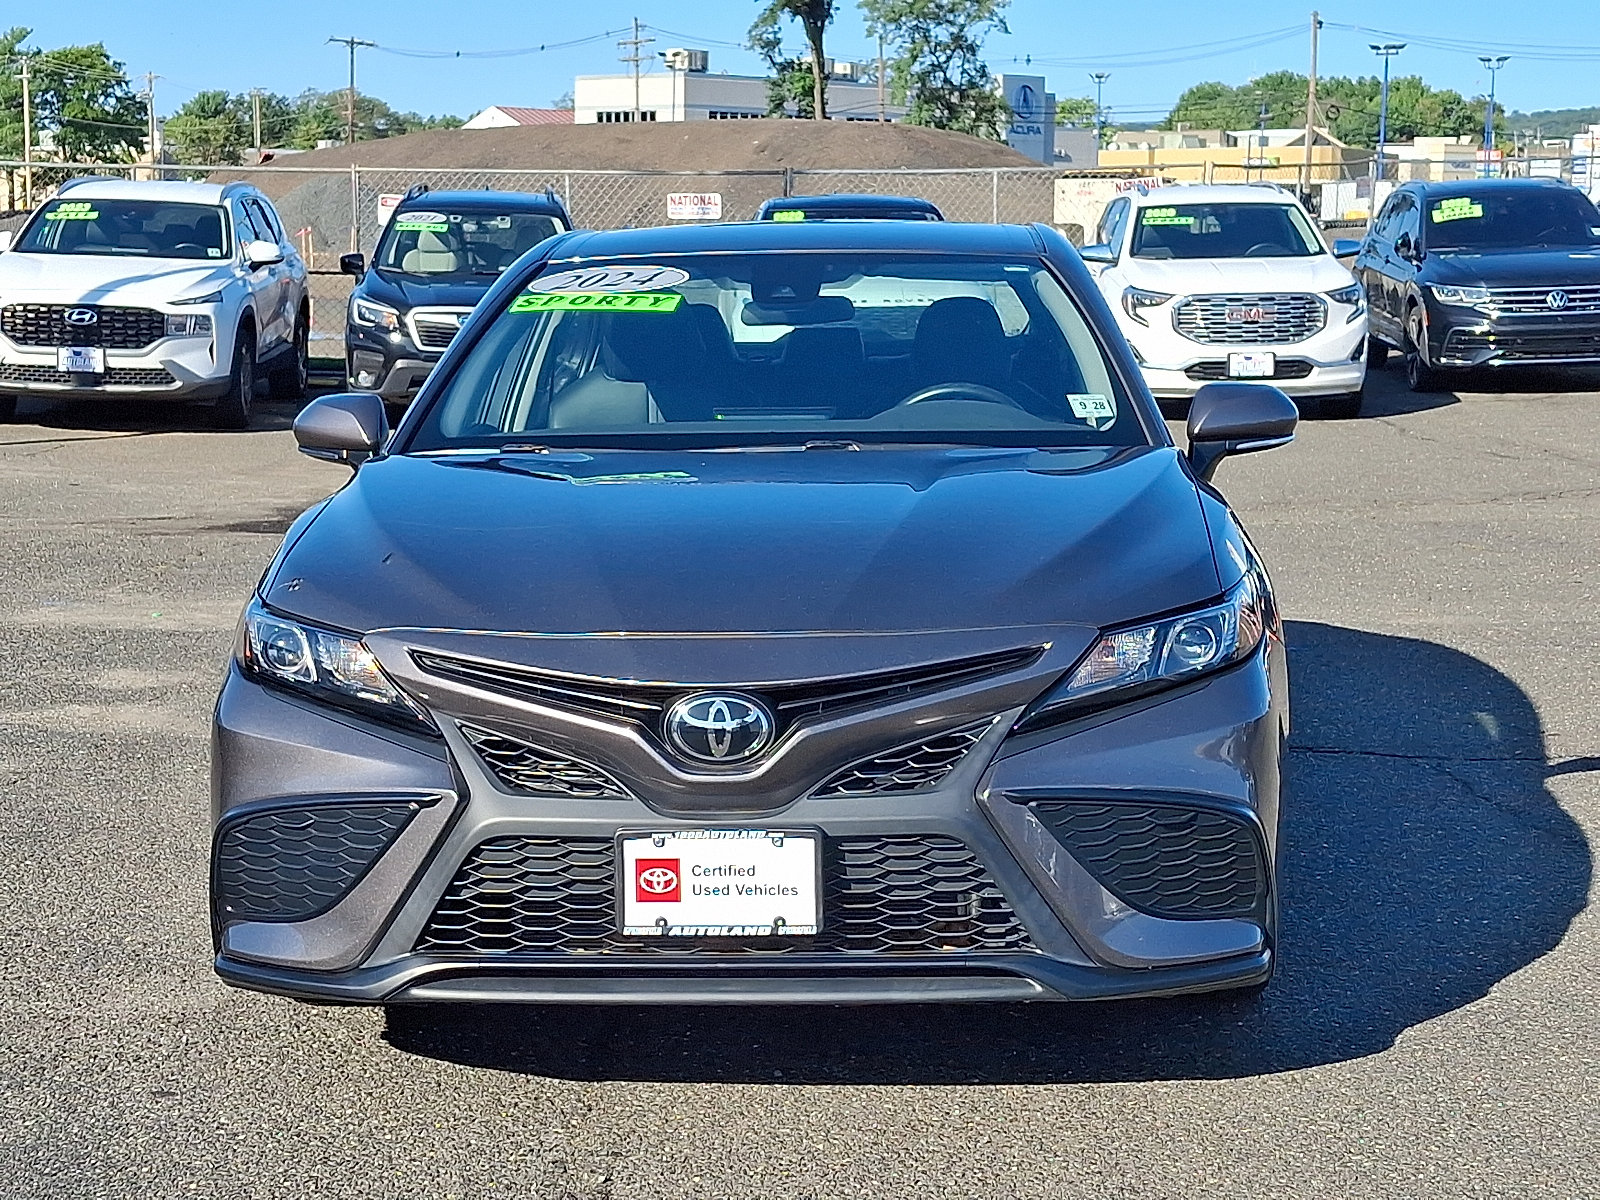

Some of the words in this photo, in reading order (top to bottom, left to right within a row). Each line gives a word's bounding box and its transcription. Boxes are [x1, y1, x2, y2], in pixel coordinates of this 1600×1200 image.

[1009, 125, 1042, 135] ACURA
[669, 195, 719, 206] NATIONAL
[551, 270, 664, 290] 2024
[516, 295, 675, 308] SPORTY
[1079, 401, 1088, 410] 9
[1092, 401, 1106, 410] 28
[691, 864, 756, 877] Certified
[692, 884, 730, 896] Used
[735, 883, 799, 896] Vehicles
[668, 926, 773, 936] AUTOLAND
